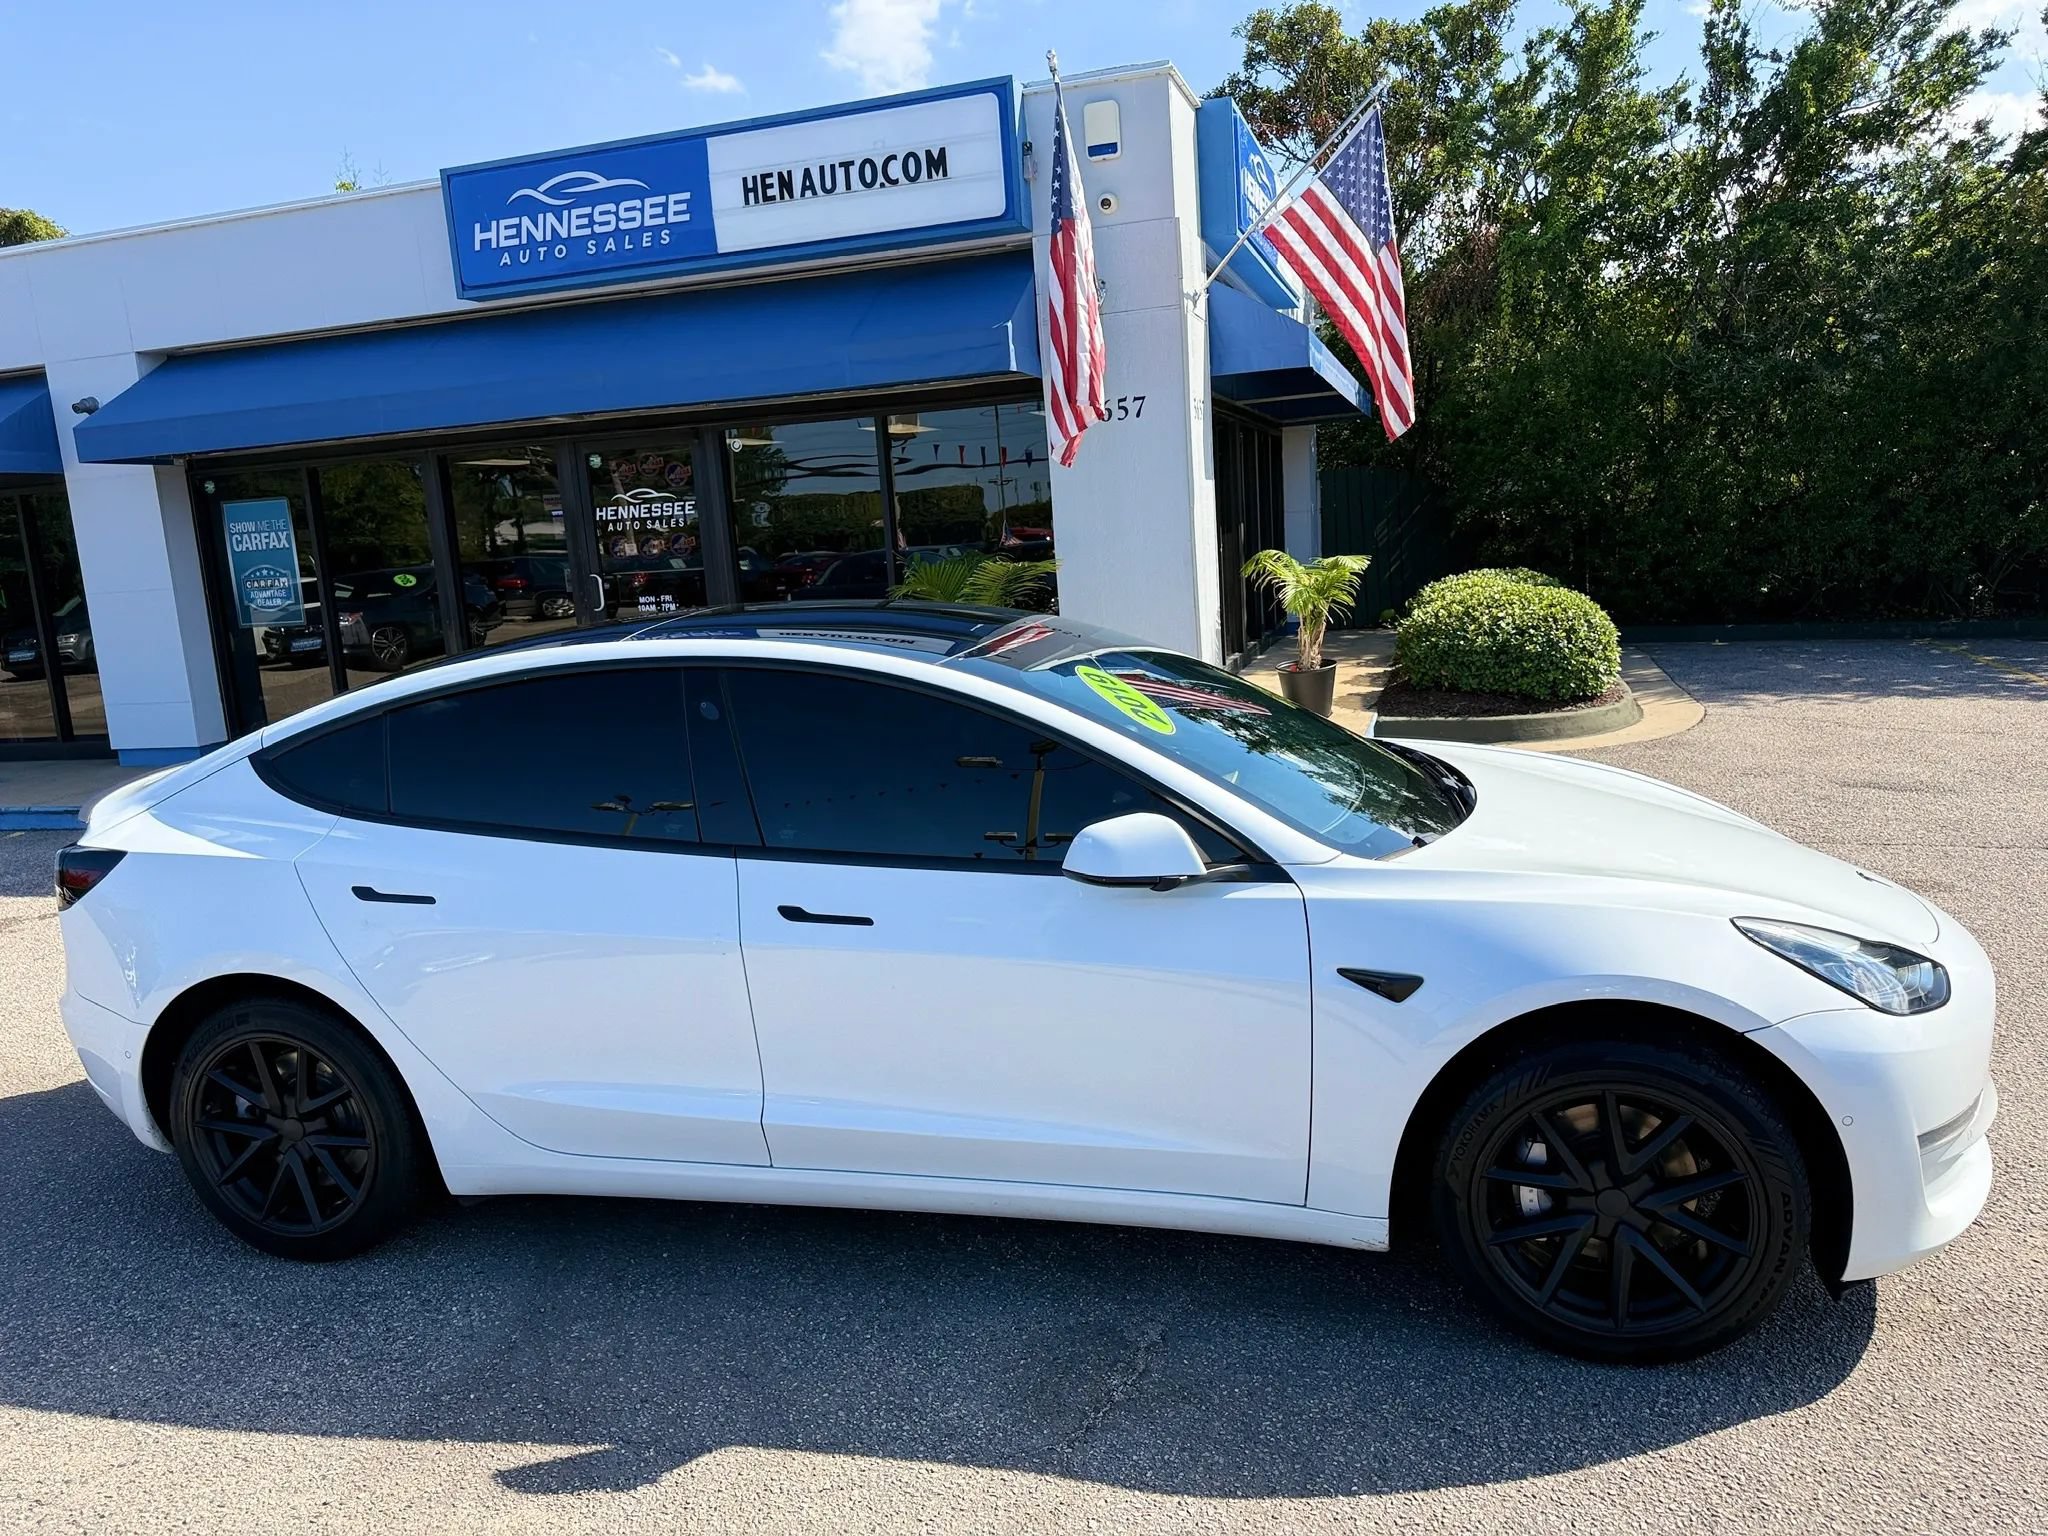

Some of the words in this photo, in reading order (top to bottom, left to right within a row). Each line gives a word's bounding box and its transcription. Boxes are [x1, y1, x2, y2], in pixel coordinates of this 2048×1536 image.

[742, 146, 950, 207] HENAUTO.COM
[473, 191, 692, 251] HENNESSEE
[499, 244, 567, 267] AUTO
[586, 229, 671, 256] SALES
[595, 501, 696, 521] HENNESSEE
[230, 521, 256, 534] SHOW
[257, 520, 270, 532] ME
[272, 518, 287, 530] THE
[607, 521, 641, 532] AUTO
[646, 518, 685, 529] SALES
[232, 531, 290, 552] CARFAX
[250, 589, 287, 599] ADVANTAGE
[257, 598, 282, 607] DEALER
[639, 595, 656, 604] MON
[660, 594, 673, 602] FRI
[638, 603, 657, 612] 10AM
[1087, 672, 1169, 727] 2019
[1452, 1102, 1499, 1161] YOKOHAMA
[1773, 1191, 1793, 1274] ADVAN
